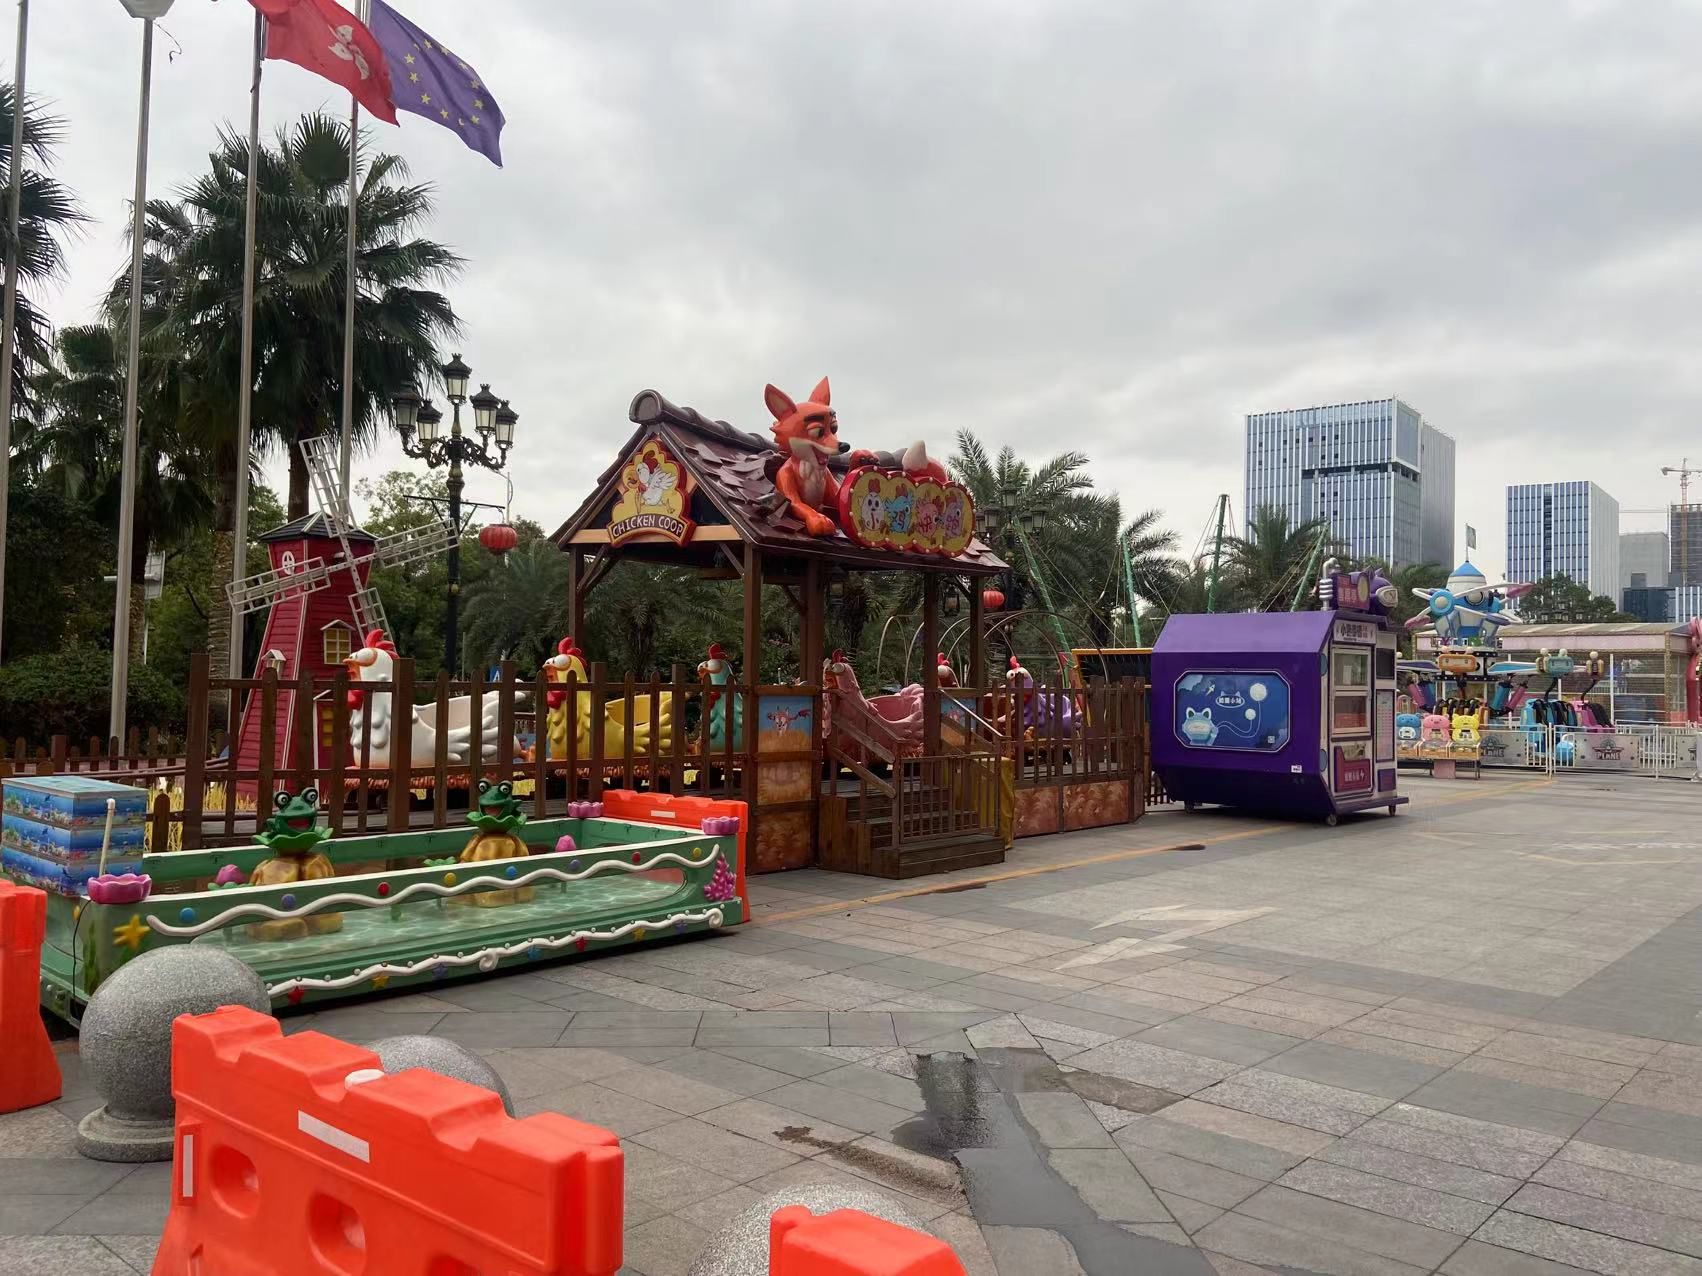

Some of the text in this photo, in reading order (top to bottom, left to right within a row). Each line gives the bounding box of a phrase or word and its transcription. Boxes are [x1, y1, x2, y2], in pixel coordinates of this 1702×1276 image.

[612, 515, 684, 537] CHICKEN COOP
[1481, 748, 1505, 758] LANE
[1596, 751, 1621, 760] PLANE
